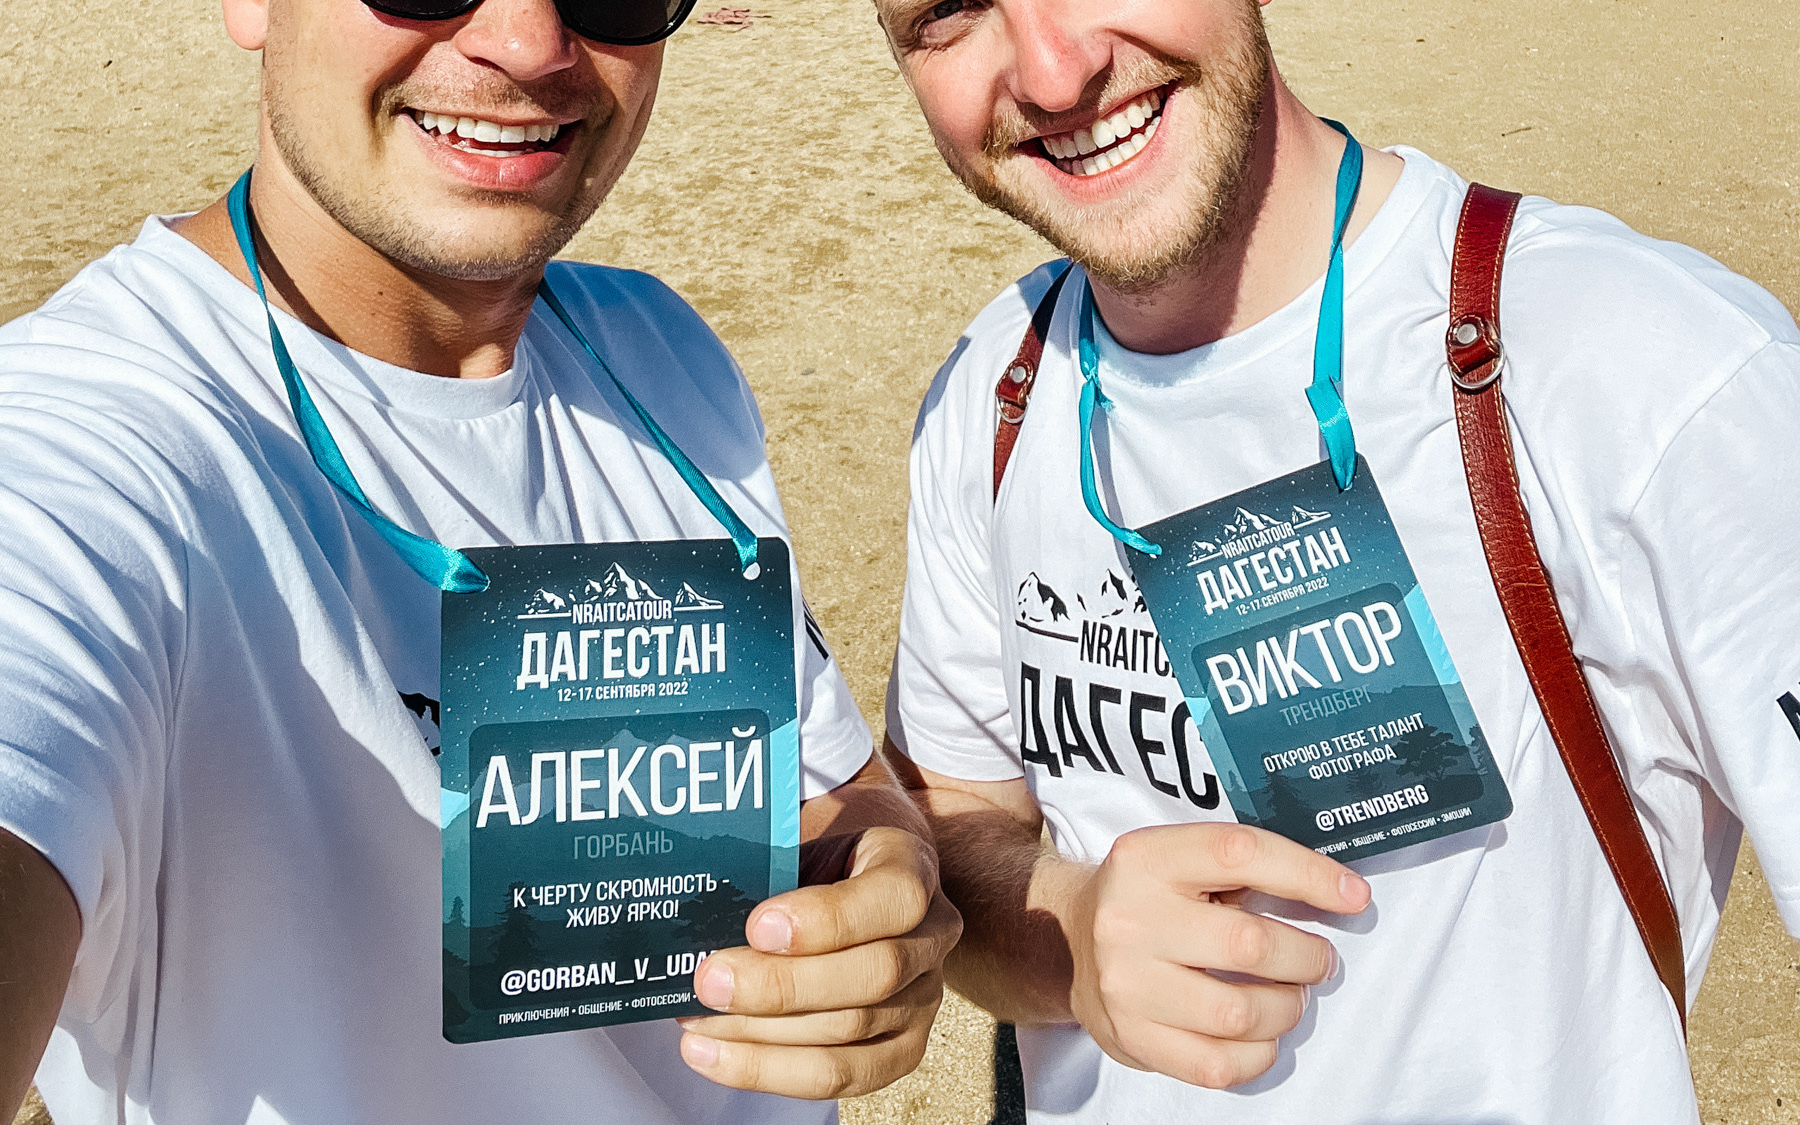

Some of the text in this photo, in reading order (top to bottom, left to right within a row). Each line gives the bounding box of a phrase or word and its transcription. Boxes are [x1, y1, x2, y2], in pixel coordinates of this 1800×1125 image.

[1221, 522, 1296, 559] NRAITCATOUR
[1197, 526, 1351, 616] ДАГЕСТАН
[572, 600, 673, 624] NRAITCATOUR
[1235, 576, 1330, 616] 12-17 СЕНТЯБРЯ 2022
[516, 623, 726, 690] ДАГЕСТАН
[1080, 619, 1177, 678] NRAITC
[1206, 601, 1402, 715] ВИКТОР
[557, 681, 689, 702] 12-17 СЕНТЯБРЯ 2022
[1279, 684, 1372, 726] ТРЕНДБЕРГ
[1263, 712, 1425, 773] ОТКРОЮ В ТЕБЕ ТАЛАНТ
[1308, 743, 1397, 780] ФОТОГРАФА
[476, 725, 763, 828] АЛЕКСЕЙ
[1315, 784, 1430, 832] @TRENDBERG
[574, 830, 674, 860] ГОРБАНЬ
[513, 887, 526, 908] К
[531, 882, 592, 906] ЧЕРТУ
[596, 873, 718, 901] СКРОМНОСТЬ
[566, 899, 679, 928] ЖИВУ ЯРКО!
[501, 950, 718, 996] @GORBAN_V_UDA
[499, 992, 691, 1025] ПРИКЛЮЧЕНИЯ ОБЩЕНИЕ ФОТОСЕССИИ
